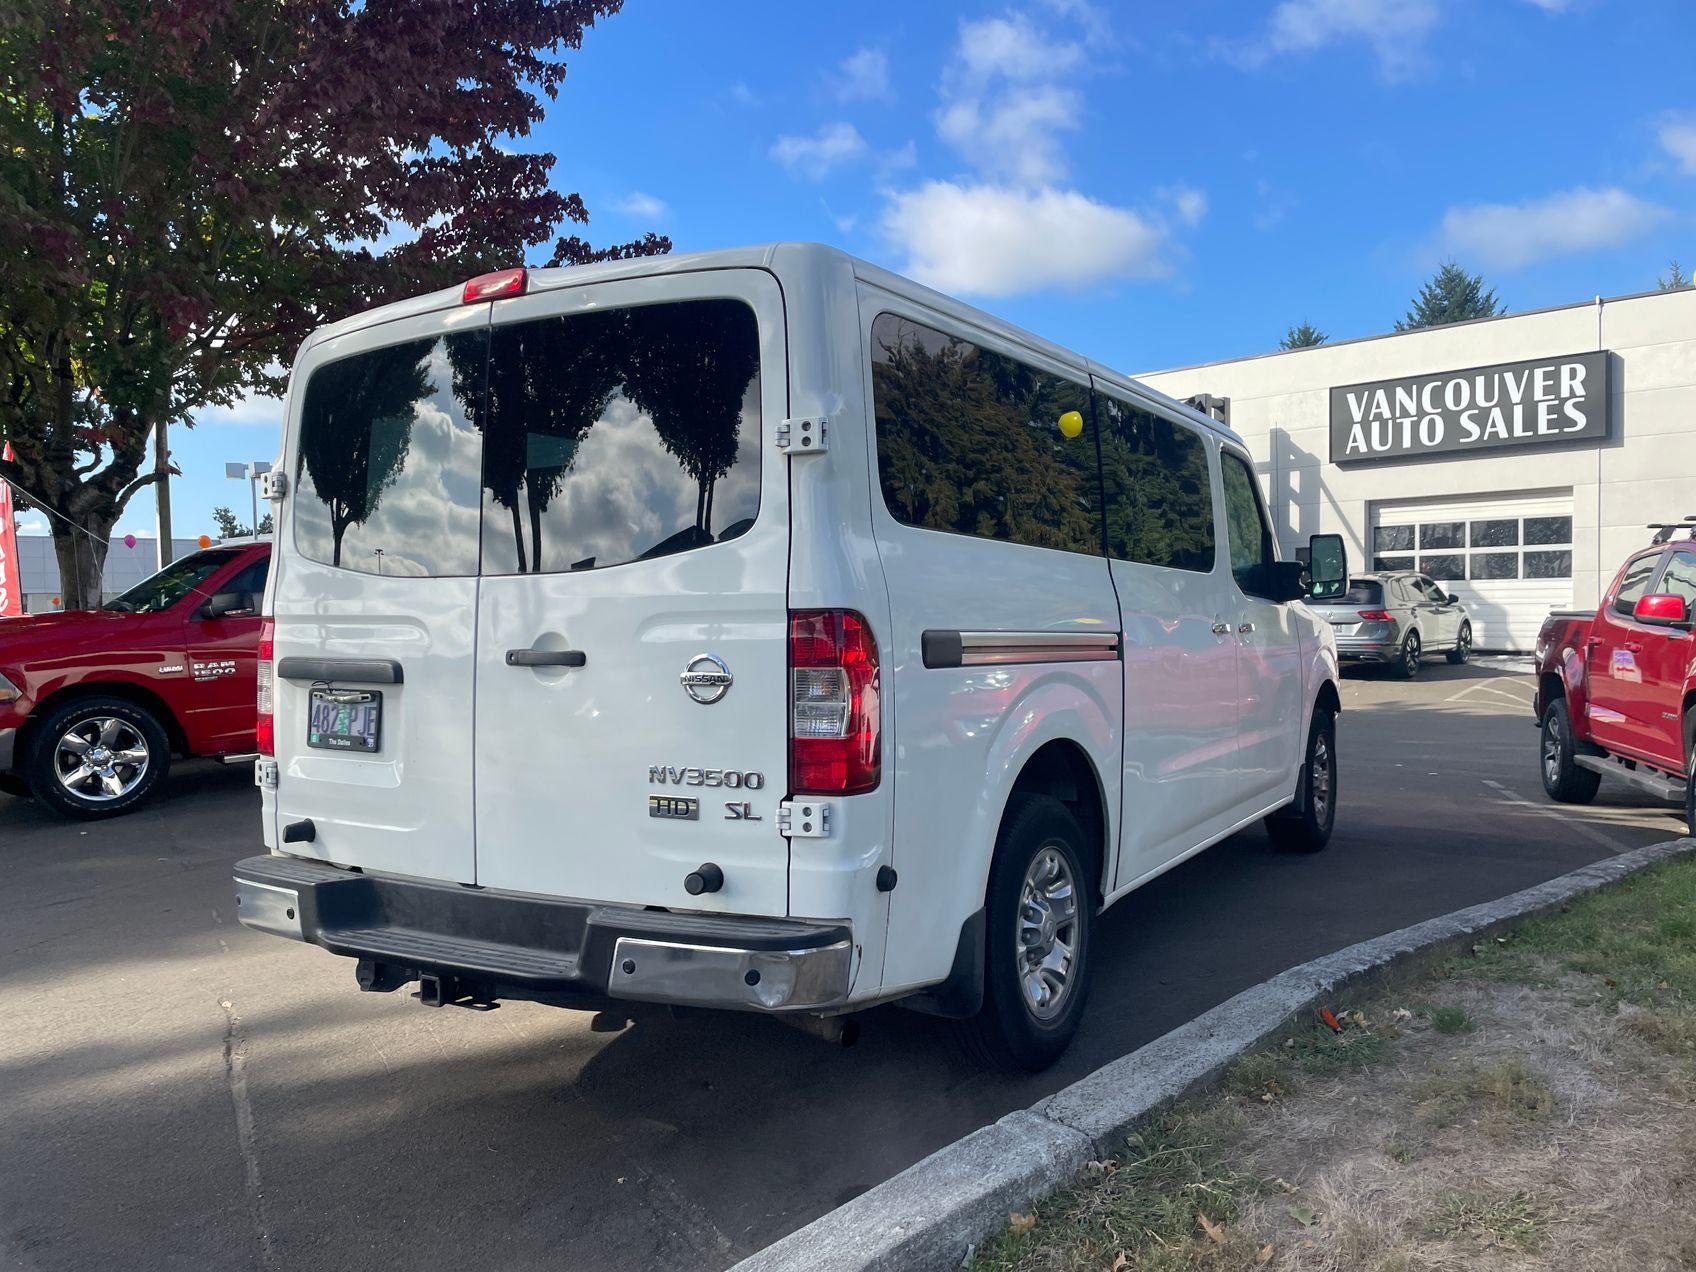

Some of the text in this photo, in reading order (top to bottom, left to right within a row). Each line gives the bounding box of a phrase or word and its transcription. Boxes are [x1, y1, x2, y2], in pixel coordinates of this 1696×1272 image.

[1346, 363, 1586, 422] VANCOUVER
[1346, 397, 1587, 454] AUTO SALES
[684, 674, 726, 684] NISSAN
[649, 765, 765, 790] NV3500
[656, 799, 690, 816] HD
[724, 801, 763, 820] SL
